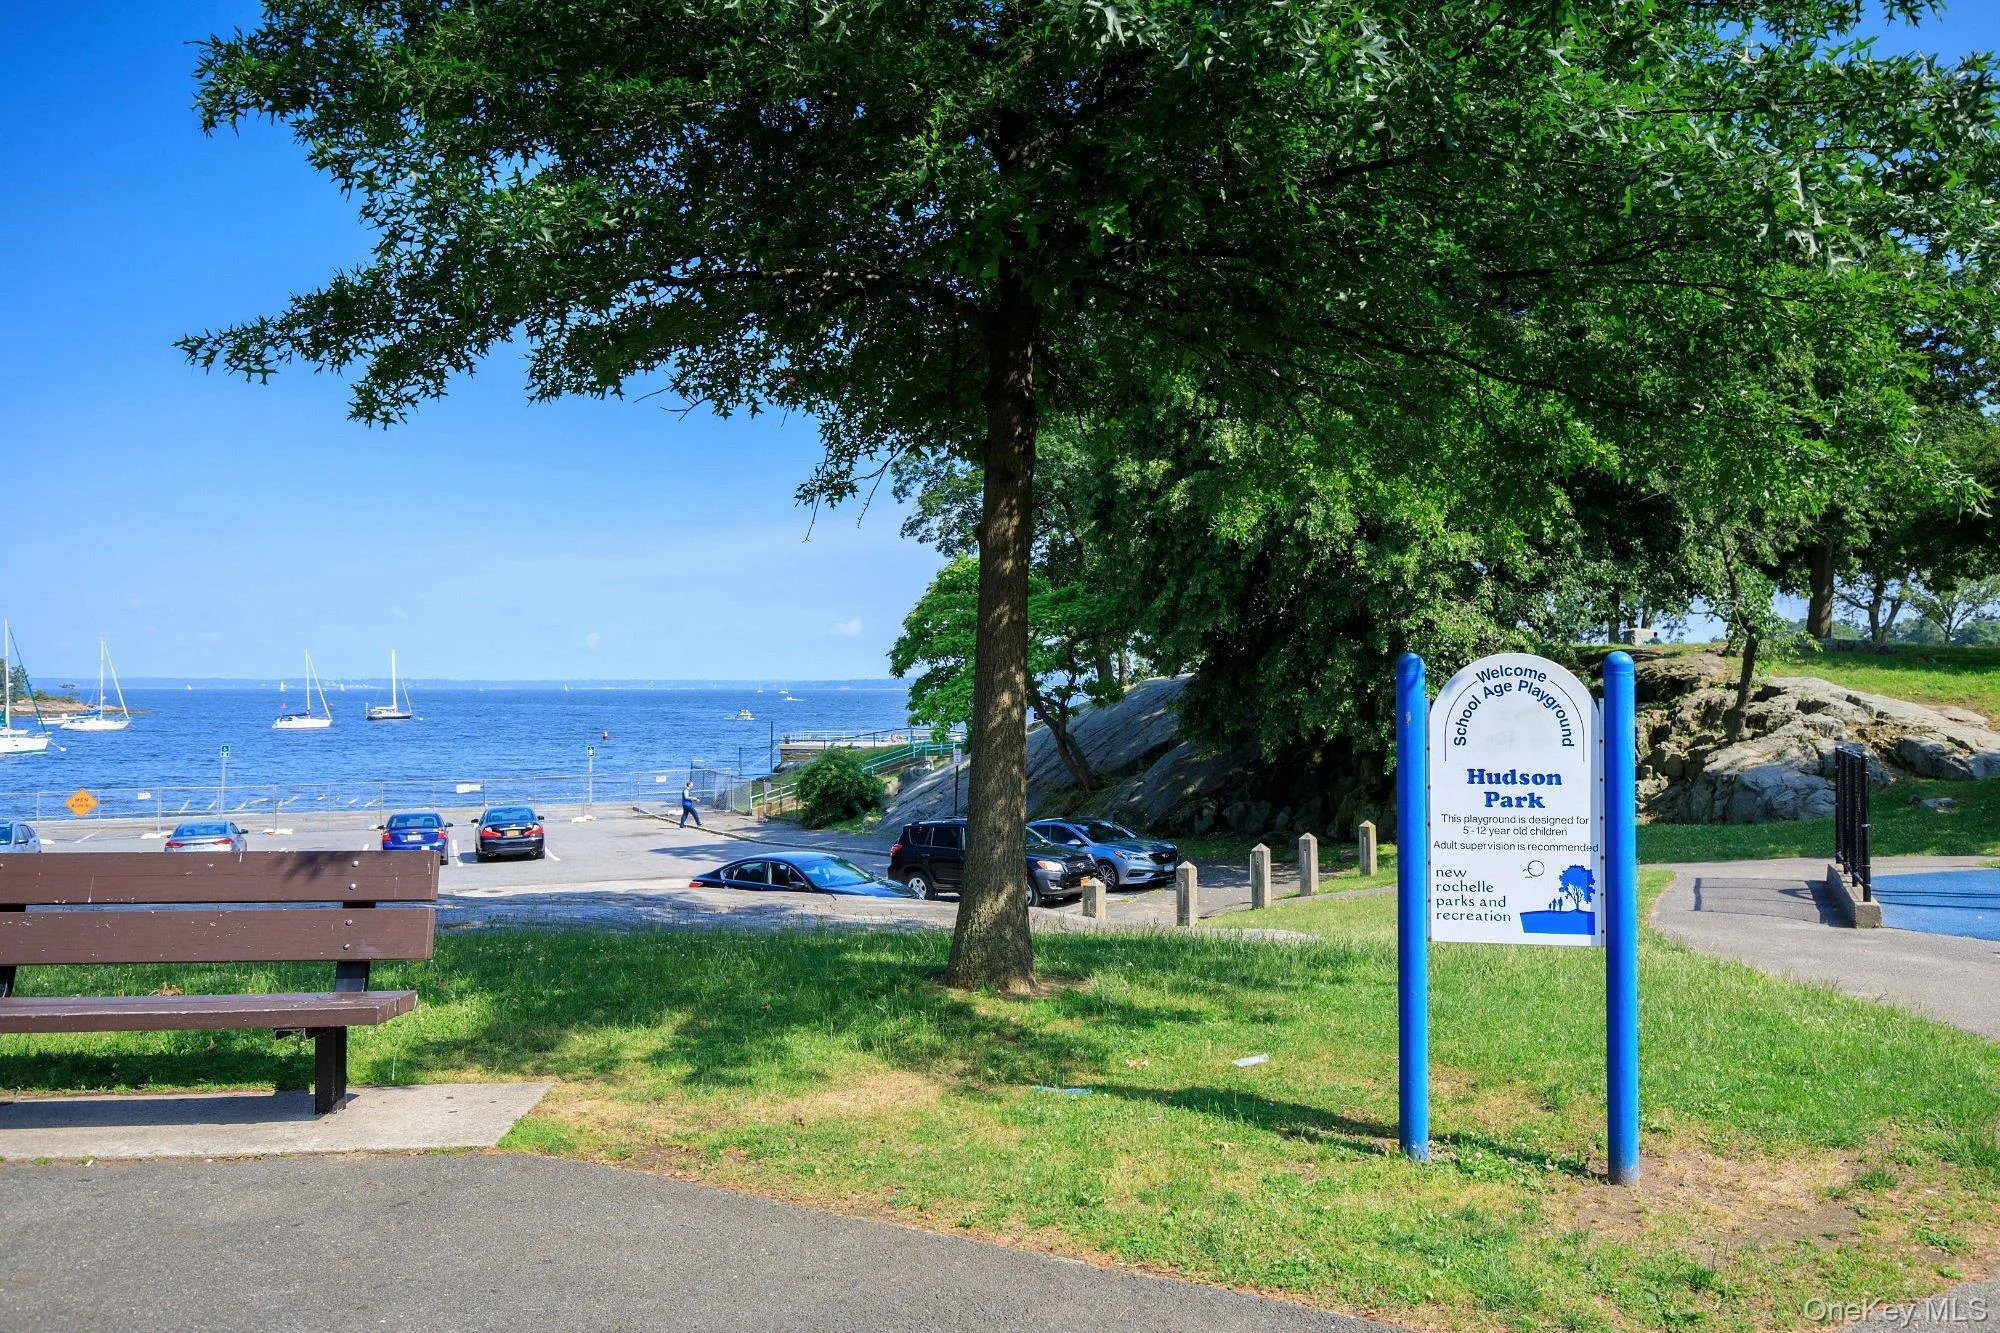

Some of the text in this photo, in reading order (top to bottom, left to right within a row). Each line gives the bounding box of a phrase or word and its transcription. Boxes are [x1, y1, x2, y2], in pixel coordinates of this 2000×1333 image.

[1475, 665, 1547, 683] Welcome
[1453, 679, 1575, 748] School Age Playground
[1466, 768, 1563, 786] Hudson
[1483, 791, 1546, 809] Park
[1441, 813, 1590, 826] This playground is designed for
[1462, 825, 1470, 835] 5
[1476, 826, 1487, 835] 12
[1488, 827, 1511, 837] year
[1512, 826, 1528, 836] old
[1529, 826, 1568, 836] children
[1433, 840, 1599, 853] Adult supervision is recommended
[1436, 869, 1467, 878] new
[1436, 879, 1494, 893] rochelle
[1436, 894, 1506, 909] parks and
[1436, 909, 1512, 922] recreation
